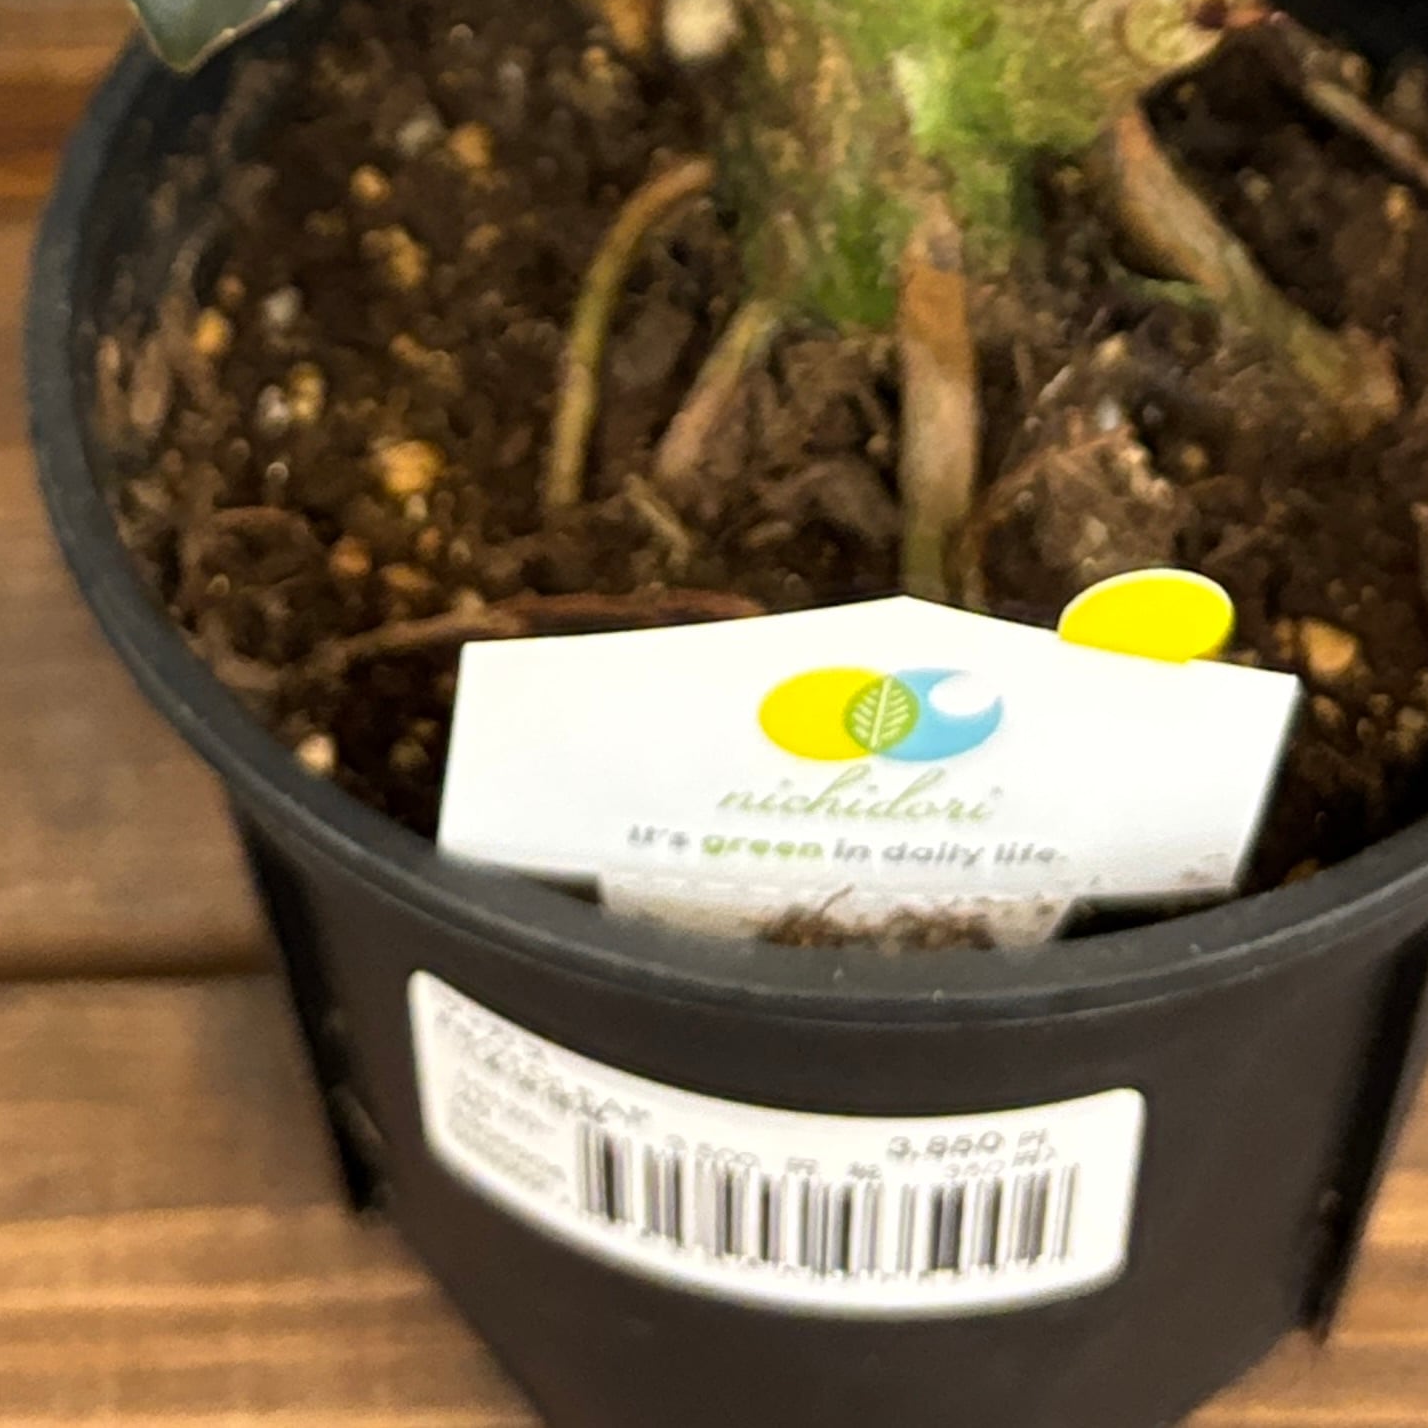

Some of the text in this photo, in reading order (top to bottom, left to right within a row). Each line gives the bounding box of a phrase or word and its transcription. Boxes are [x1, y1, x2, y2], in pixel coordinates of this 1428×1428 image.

[716, 763, 994, 822] nichidori
[700, 834, 822, 857] green
[832, 837, 872, 862] in
[881, 842, 985, 868] daily
